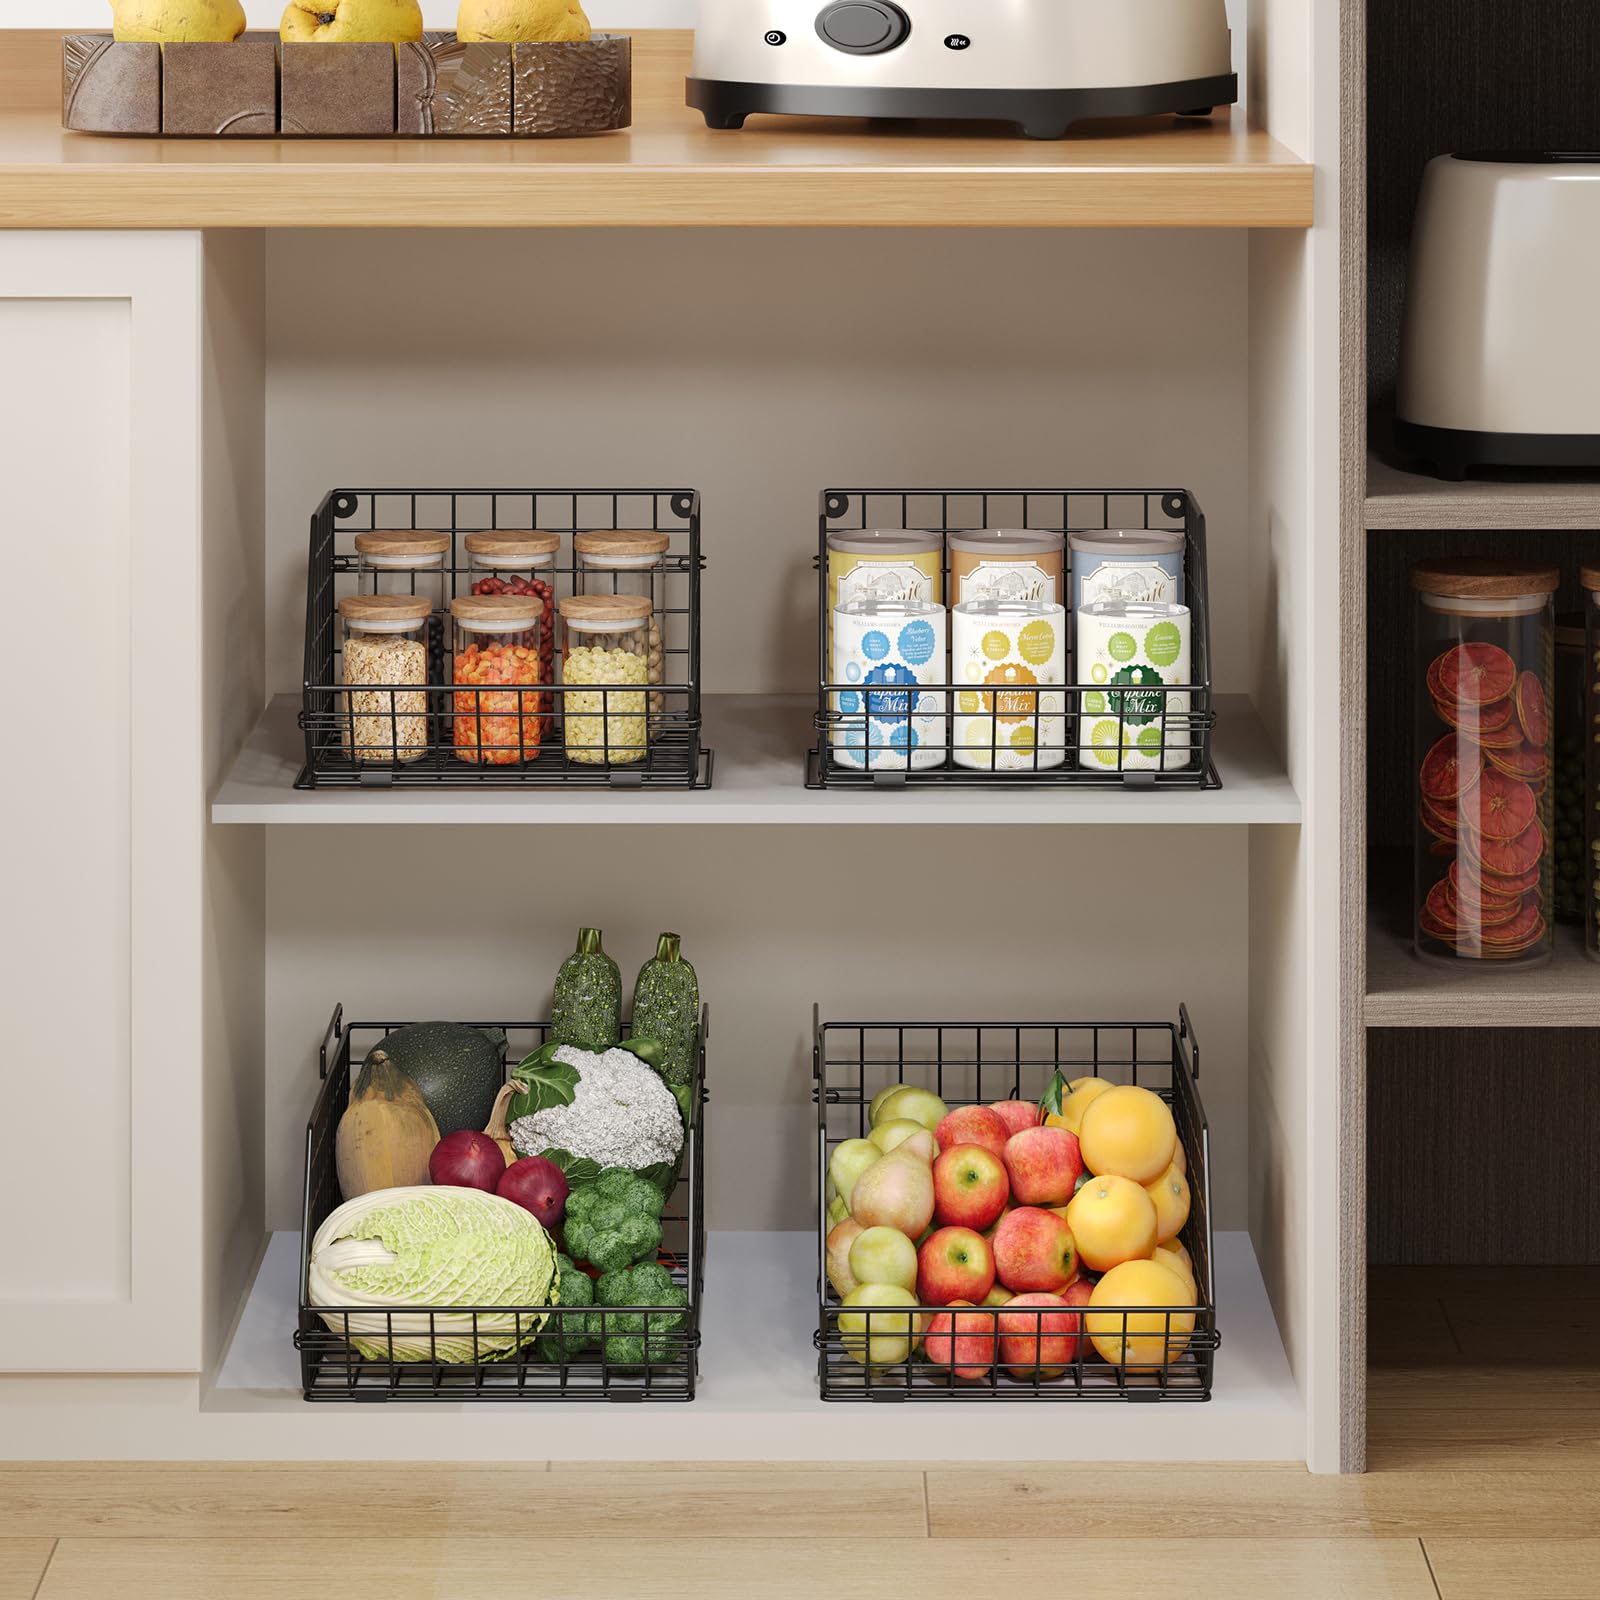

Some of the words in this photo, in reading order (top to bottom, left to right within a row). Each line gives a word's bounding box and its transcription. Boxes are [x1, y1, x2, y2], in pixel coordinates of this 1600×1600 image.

[879, 697, 909, 712] Mix
[1000, 697, 1031, 711] Mix
[1127, 698, 1158, 713] Mix
